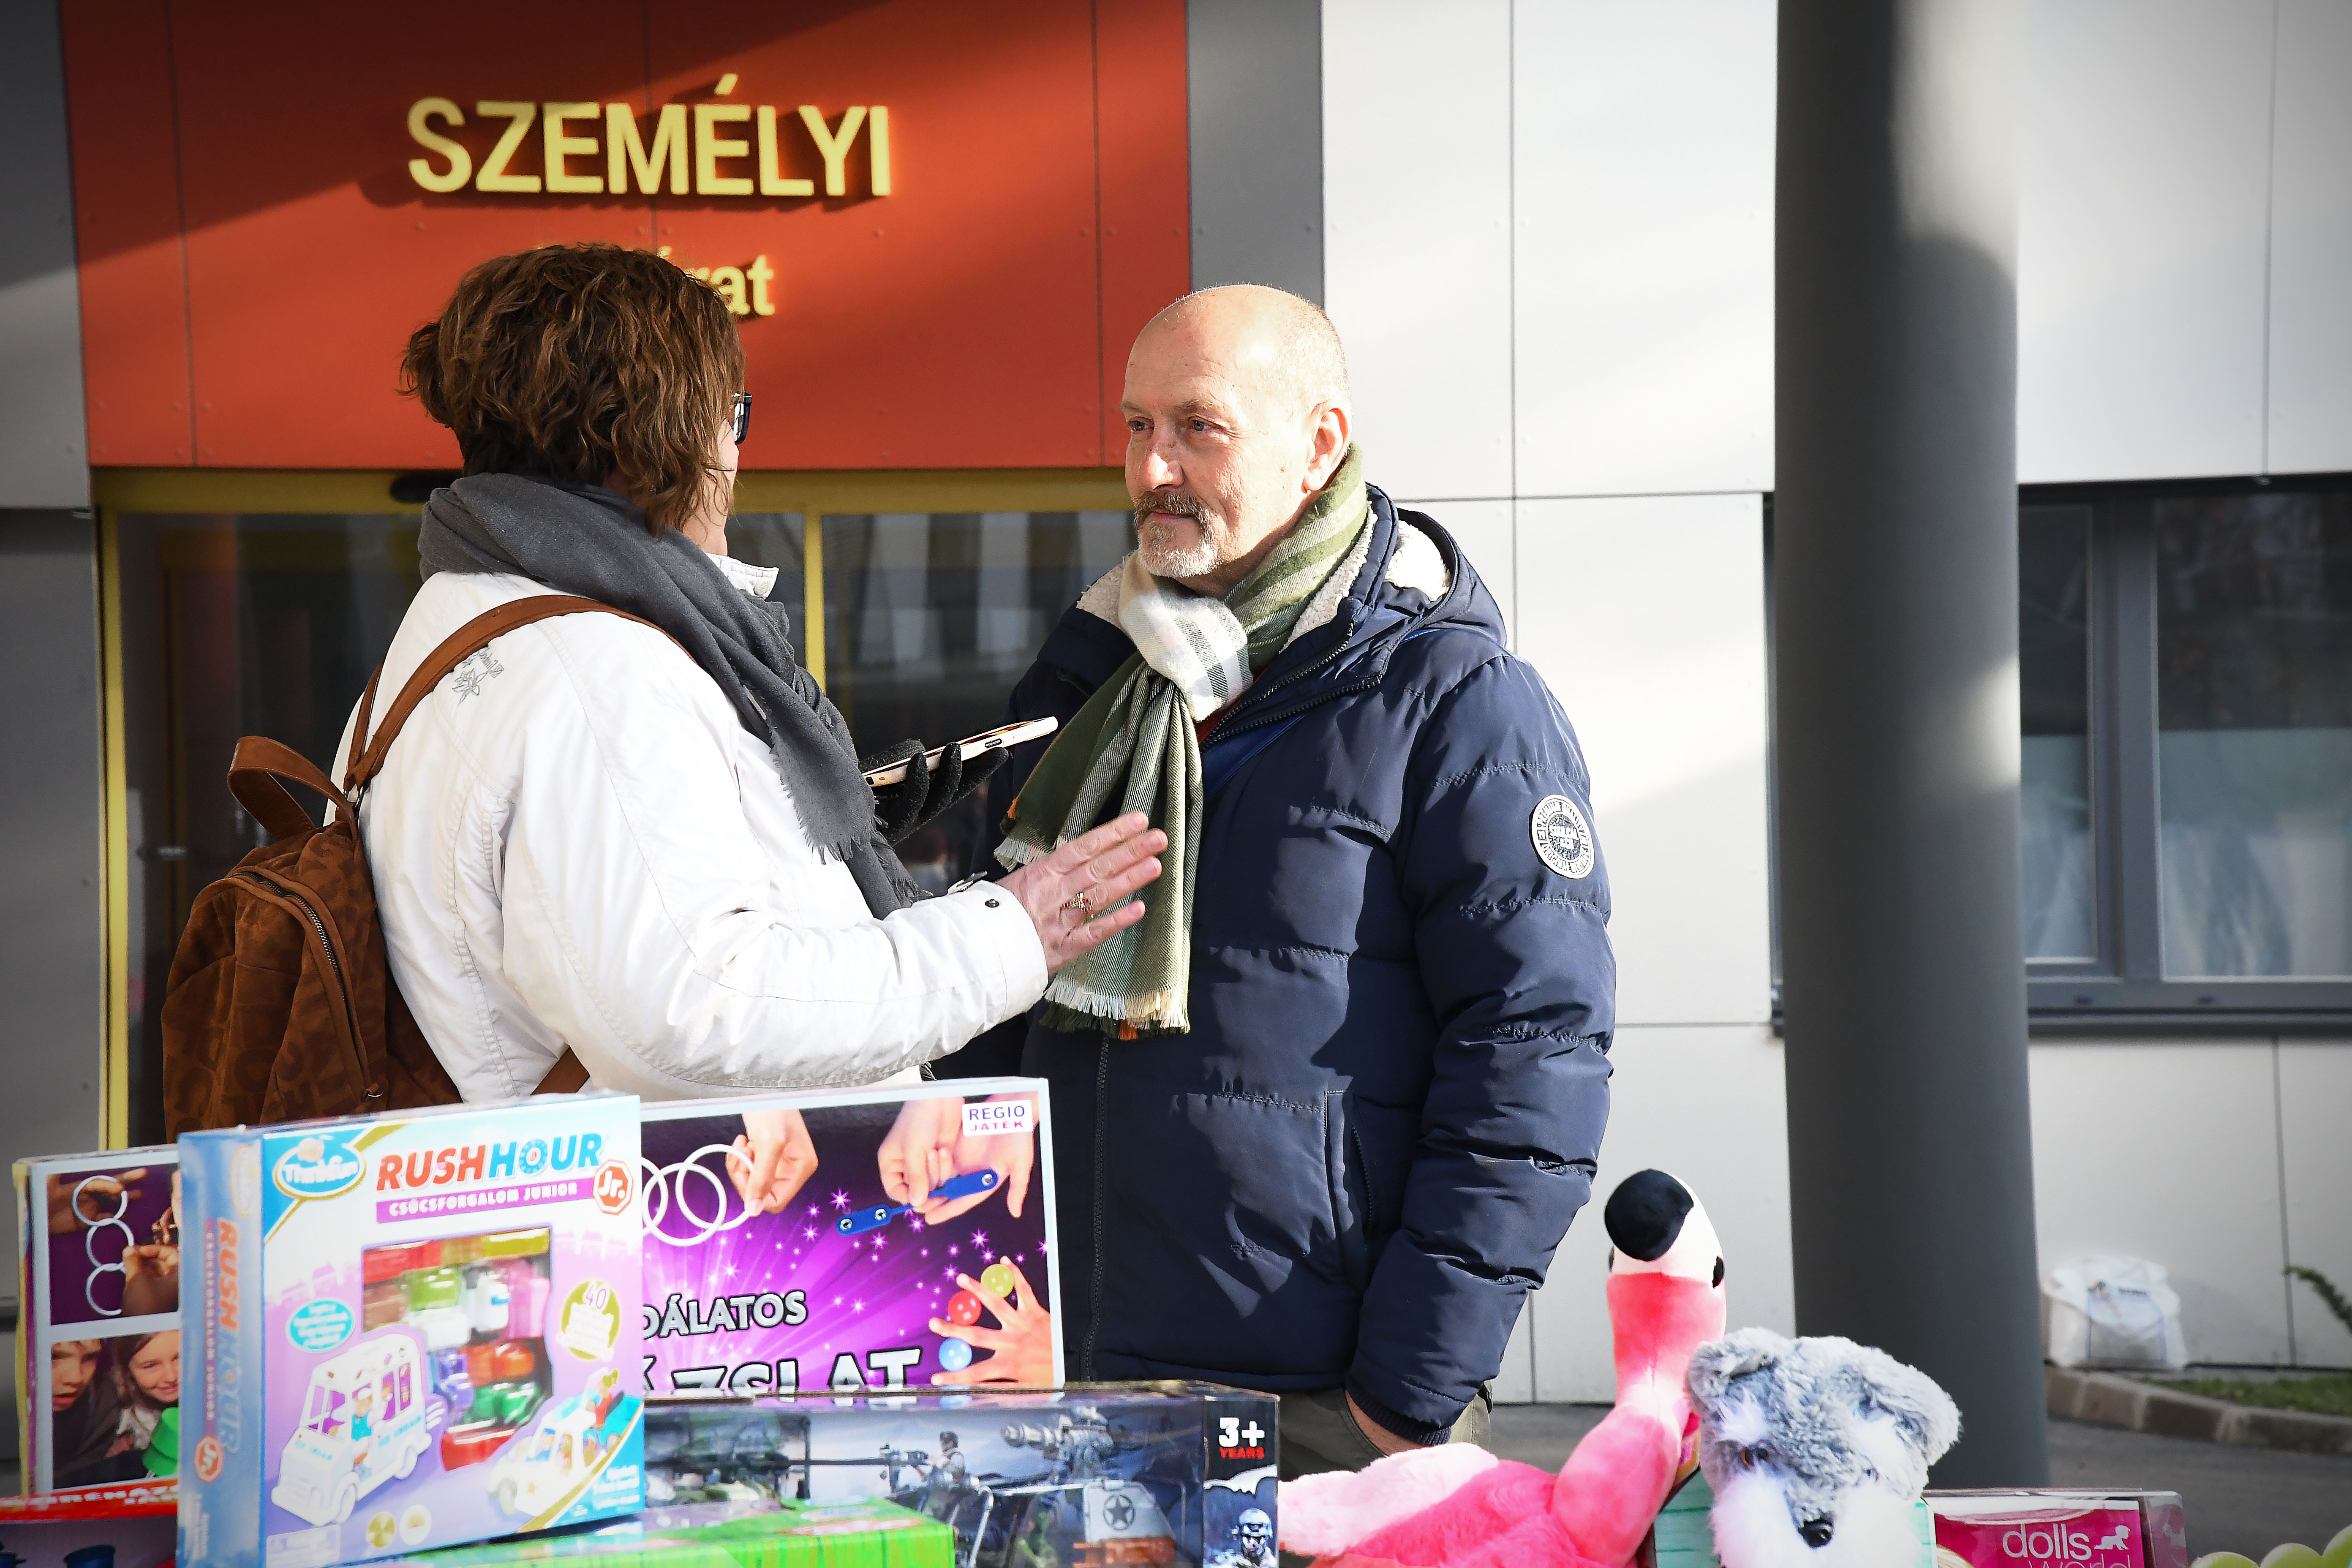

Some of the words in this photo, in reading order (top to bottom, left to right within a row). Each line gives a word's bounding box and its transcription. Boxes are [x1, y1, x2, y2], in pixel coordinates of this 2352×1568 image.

[407, 73, 891, 196] SZEMÉLYI
[969, 1105, 1024, 1120] REGIO
[523, 1182, 578, 1201] JUNIOR
[598, 1170, 626, 1200] Jr.
[585, 1285, 607, 1309] 40
[1219, 1417, 1265, 1447] 3+
[1219, 1447, 1265, 1459] YEARS
[2002, 1523, 2092, 1560] dolls
